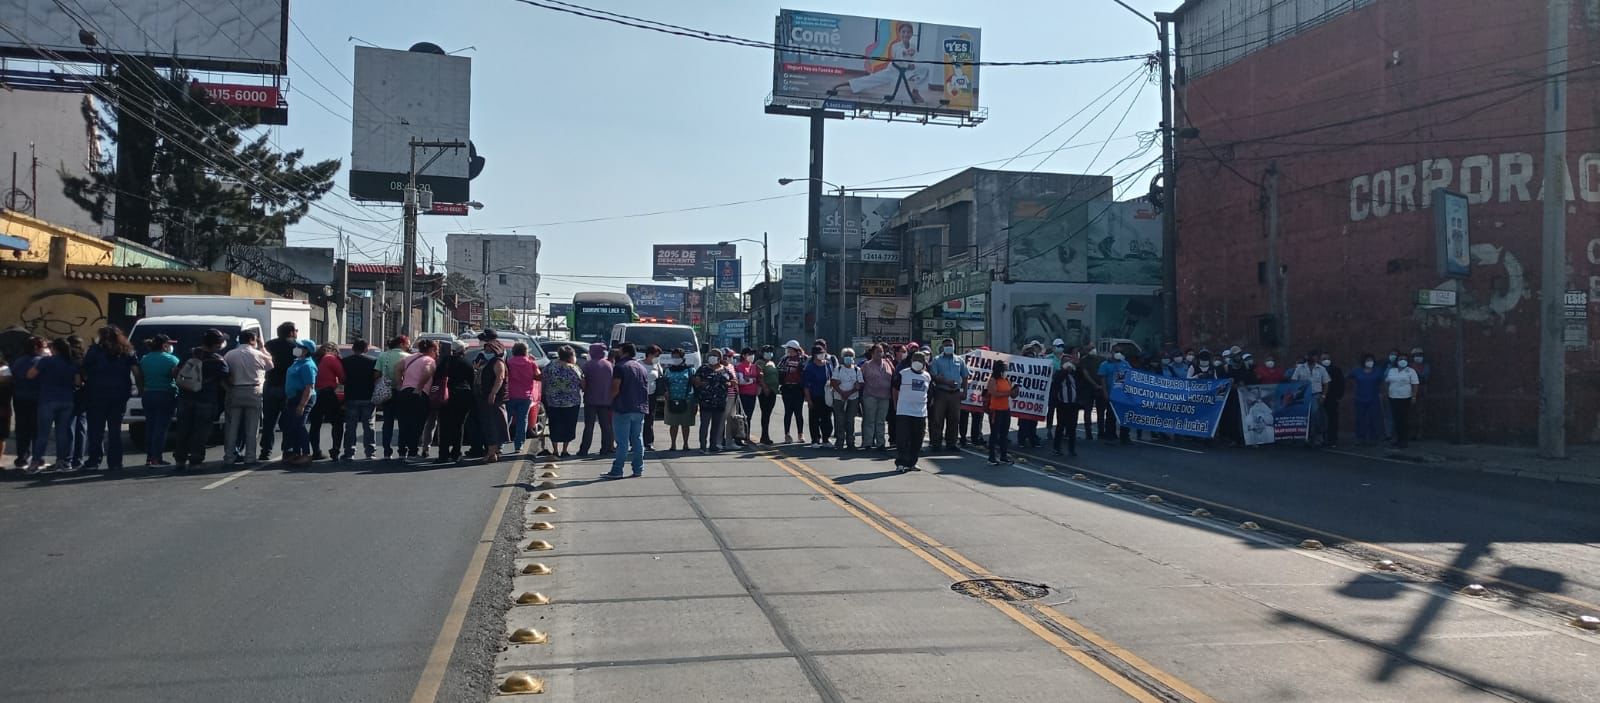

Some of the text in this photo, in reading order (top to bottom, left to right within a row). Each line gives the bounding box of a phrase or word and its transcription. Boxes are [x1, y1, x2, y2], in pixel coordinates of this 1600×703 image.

[792, 27, 840, 45] Comé
[945, 42, 968, 52] YES
[657, 250, 696, 259] 20% DE
[1123, 384, 1216, 405] SINDICATO NACIONAL HOSPITAL
[1011, 399, 1044, 413] TODOS
[1141, 399, 1195, 415] SAN JUAN DE DIOS
[1162, 417, 1173, 428] en
[1174, 416, 1183, 430] la
[1183, 418, 1209, 433] lucha!
